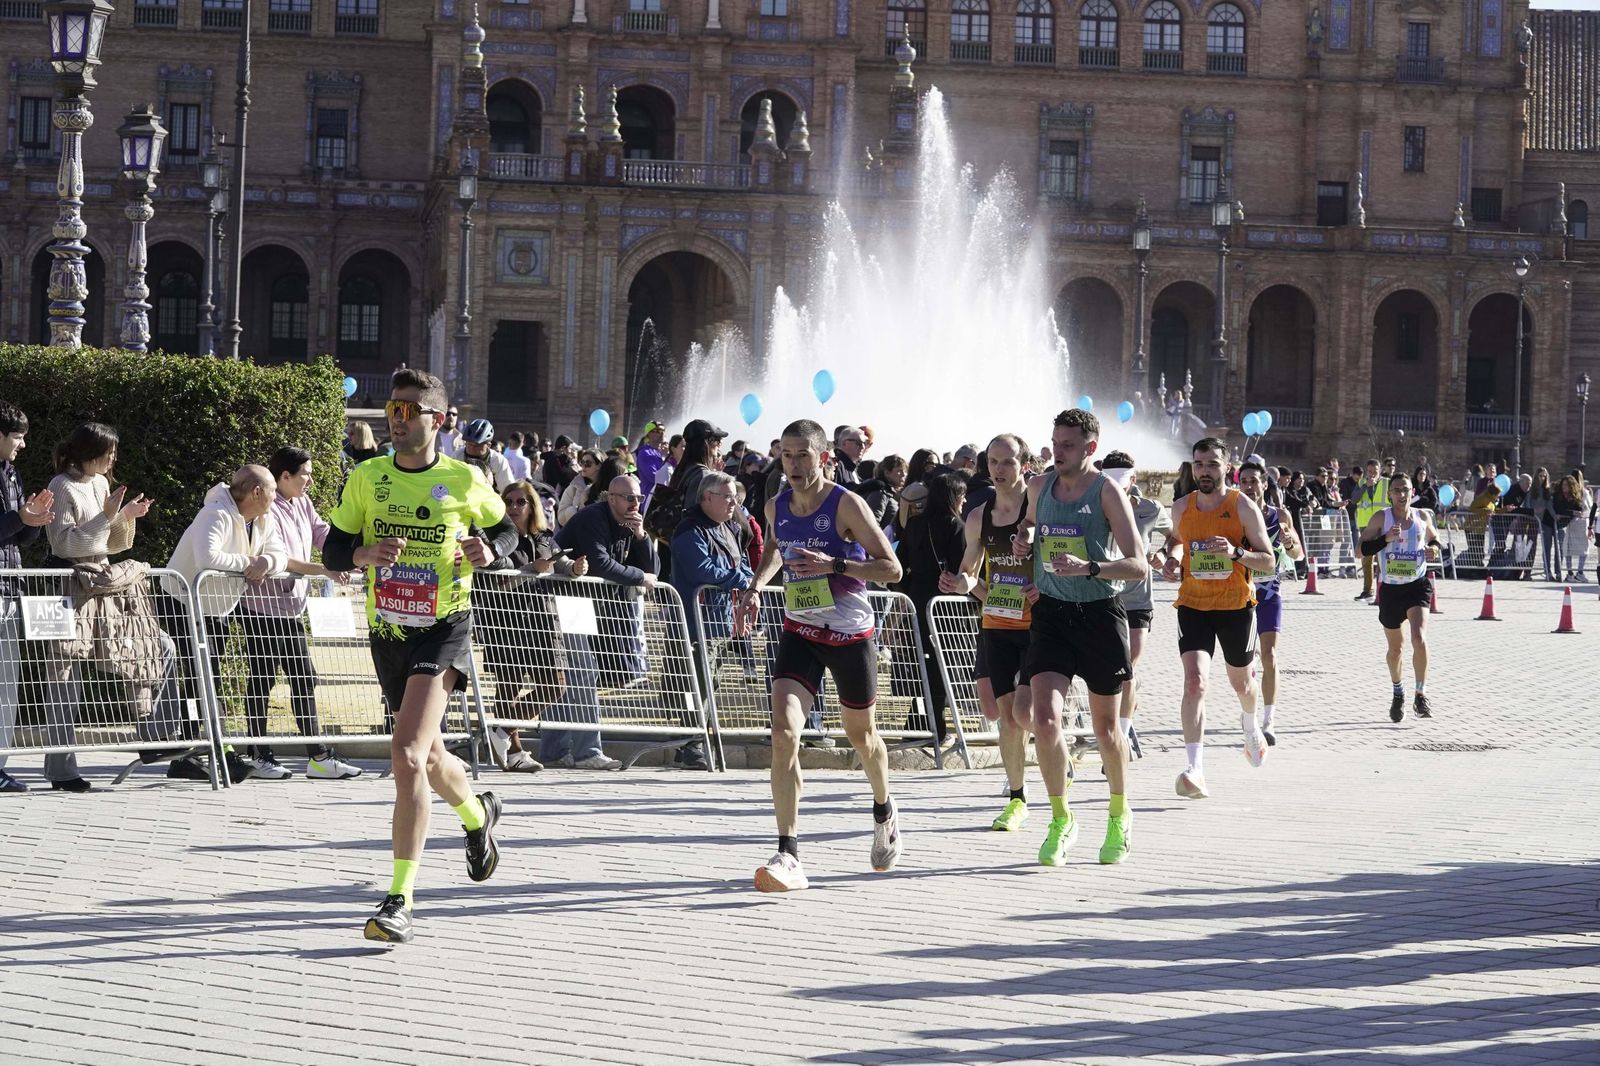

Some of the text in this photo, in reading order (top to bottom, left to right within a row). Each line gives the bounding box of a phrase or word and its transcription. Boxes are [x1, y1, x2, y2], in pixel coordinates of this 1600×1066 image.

[388, 504, 414, 514] BCL
[374, 520, 446, 543] GLADIATORS
[1051, 527, 1077, 535] ZURICH
[807, 537, 829, 548] Eibar
[408, 549, 442, 558] PANCHO
[1198, 561, 1224, 570] JULIEN
[396, 570, 431, 580] ZURICH
[1001, 575, 1024, 584] ZURICH
[396, 587, 414, 597] 1180
[378, 595, 432, 614] V.SOLBES
[986, 595, 1023, 608] CORENTIN
[36, 602, 64, 620] AMS
[418, 662, 440, 670] TERREX
